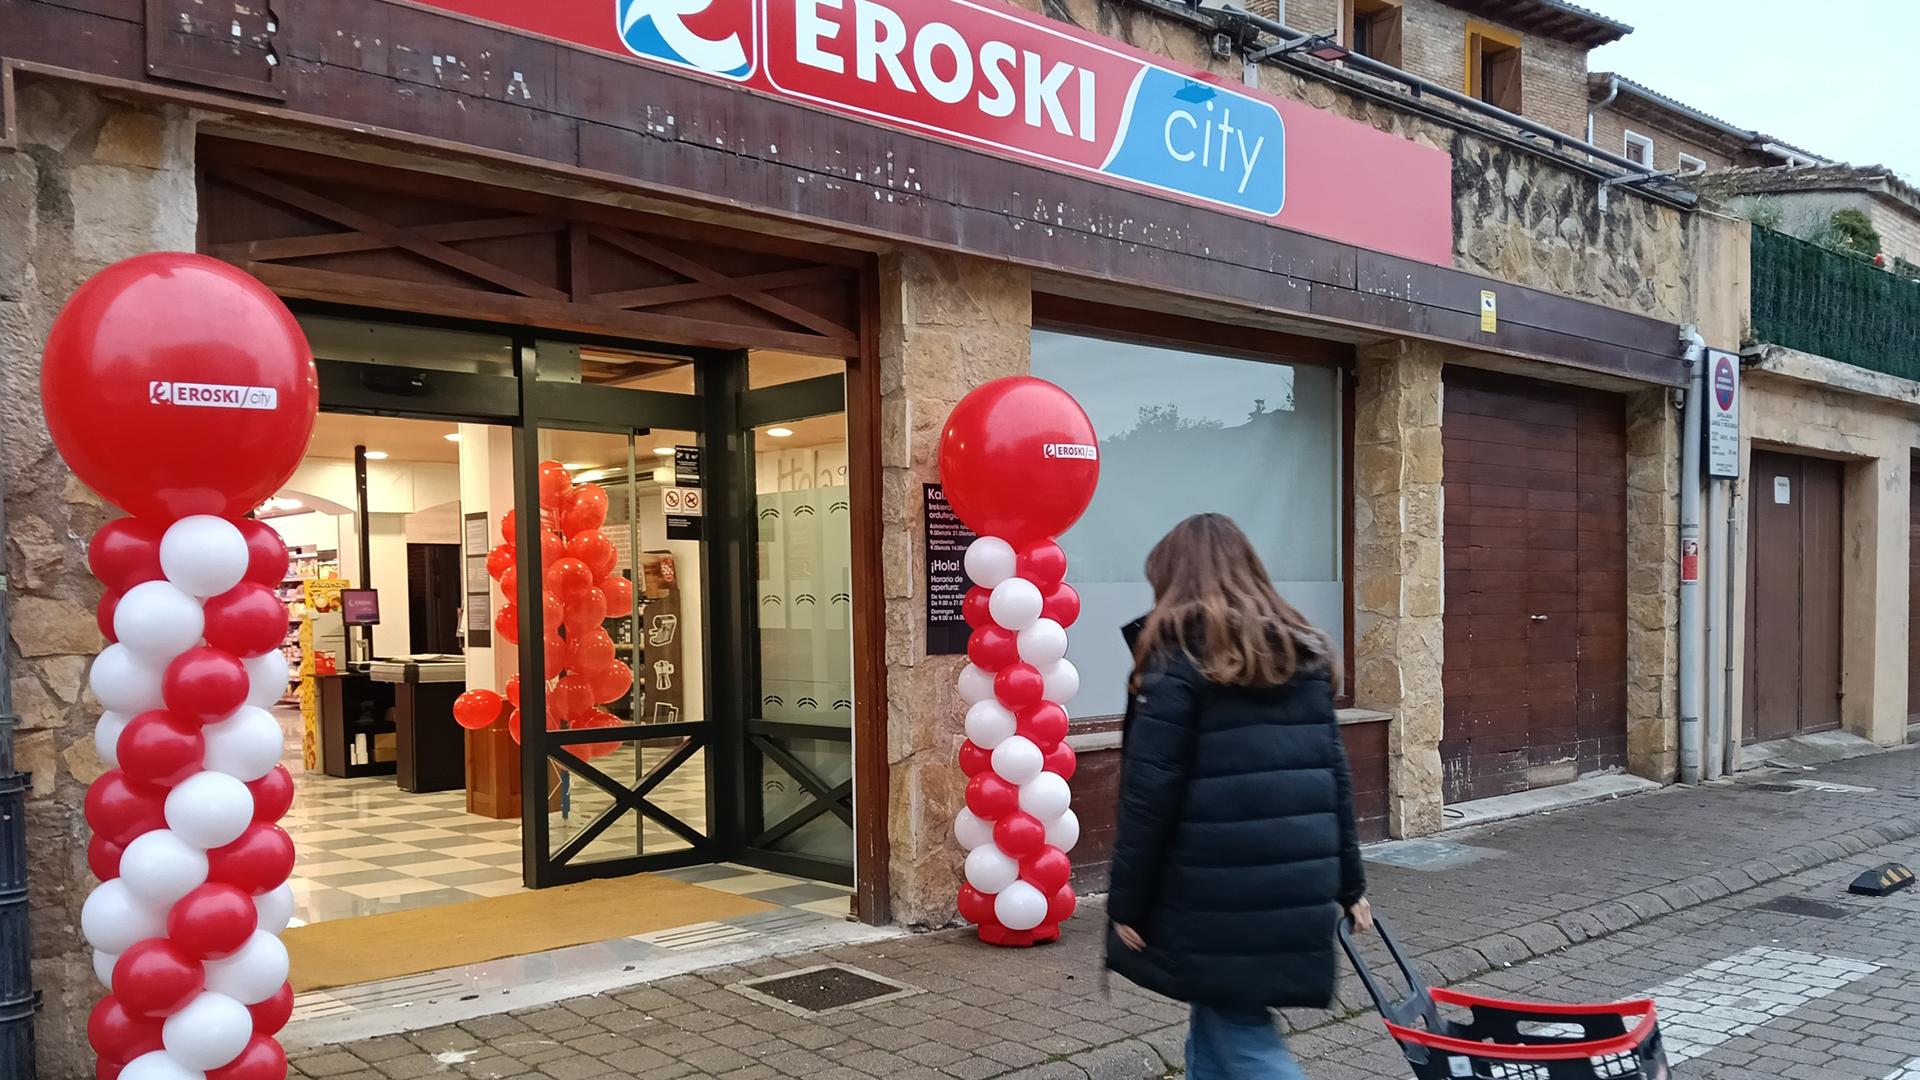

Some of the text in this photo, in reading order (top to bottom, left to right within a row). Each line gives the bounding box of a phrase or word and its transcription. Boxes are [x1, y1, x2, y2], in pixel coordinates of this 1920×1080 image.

[796, 0, 1265, 194] EROSKI city
[177, 386, 271, 407] EROSKI city
[1058, 446, 1085, 456] EROSKI
[928, 488, 947, 500] Kai
[931, 559, 960, 574] ¡Hola!
[931, 575, 964, 583] Horario de
[931, 584, 960, 592] apertura:
